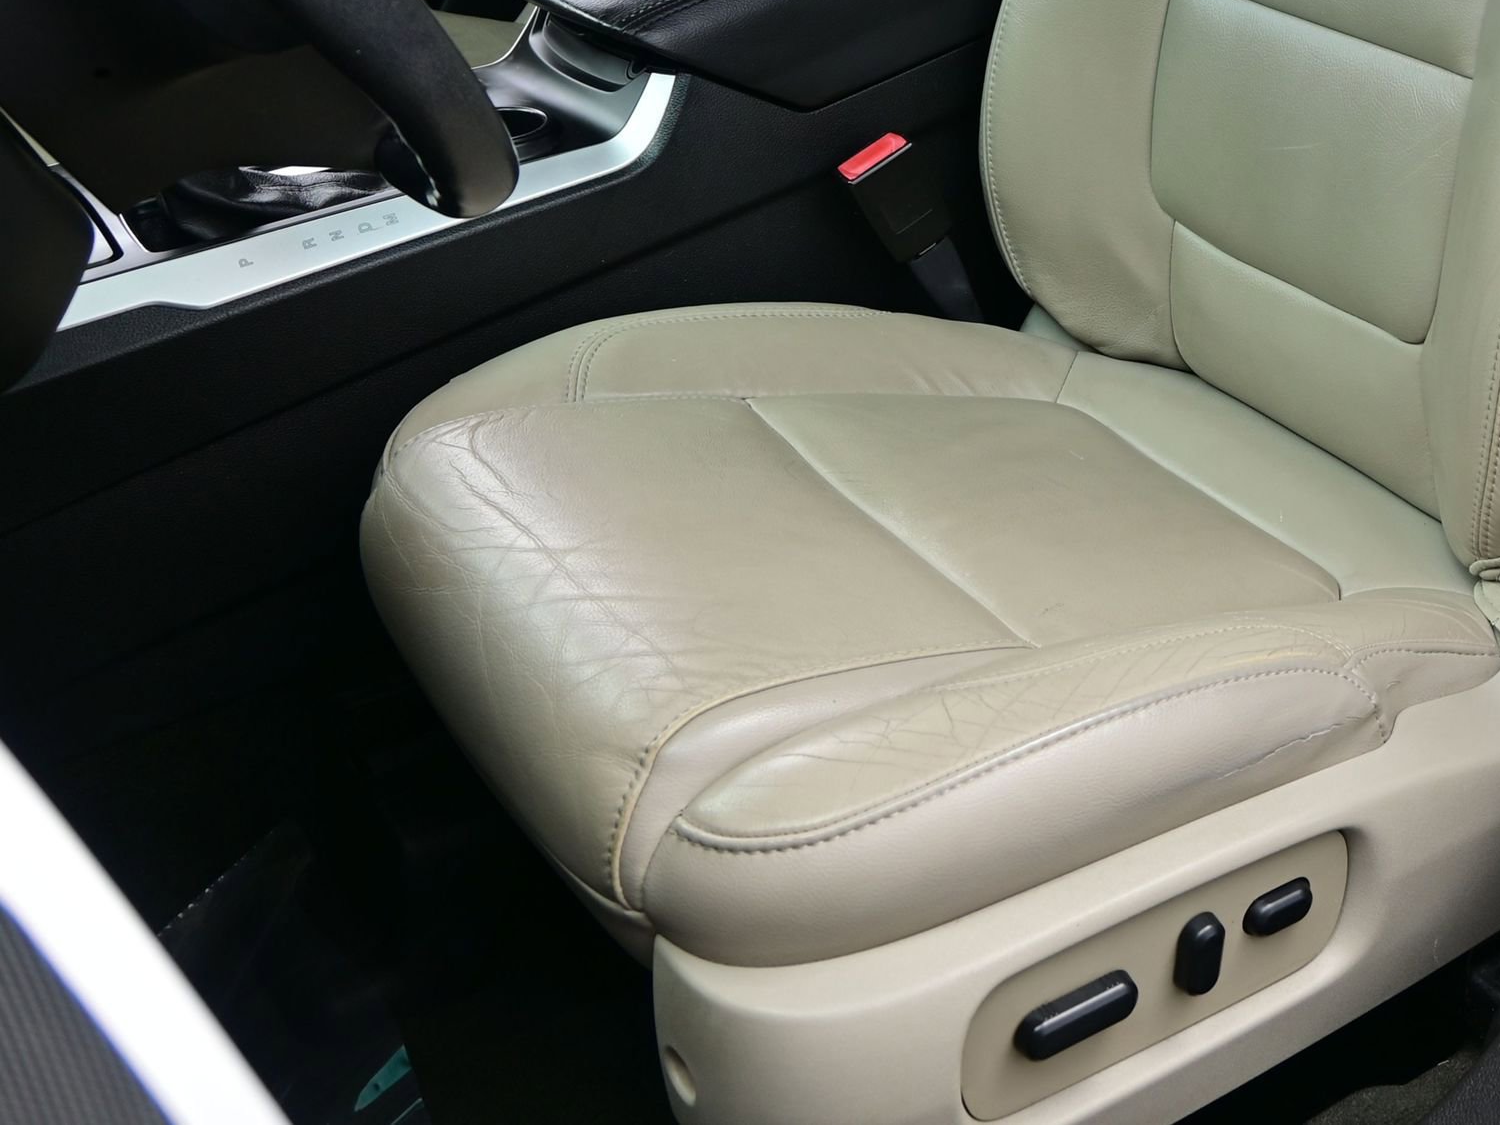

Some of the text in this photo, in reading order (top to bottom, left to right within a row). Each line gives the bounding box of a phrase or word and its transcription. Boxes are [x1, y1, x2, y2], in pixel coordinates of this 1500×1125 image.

[238, 257, 254, 268] P
[302, 237, 318, 250] R
[328, 229, 345, 242] N
[357, 222, 374, 234] D
